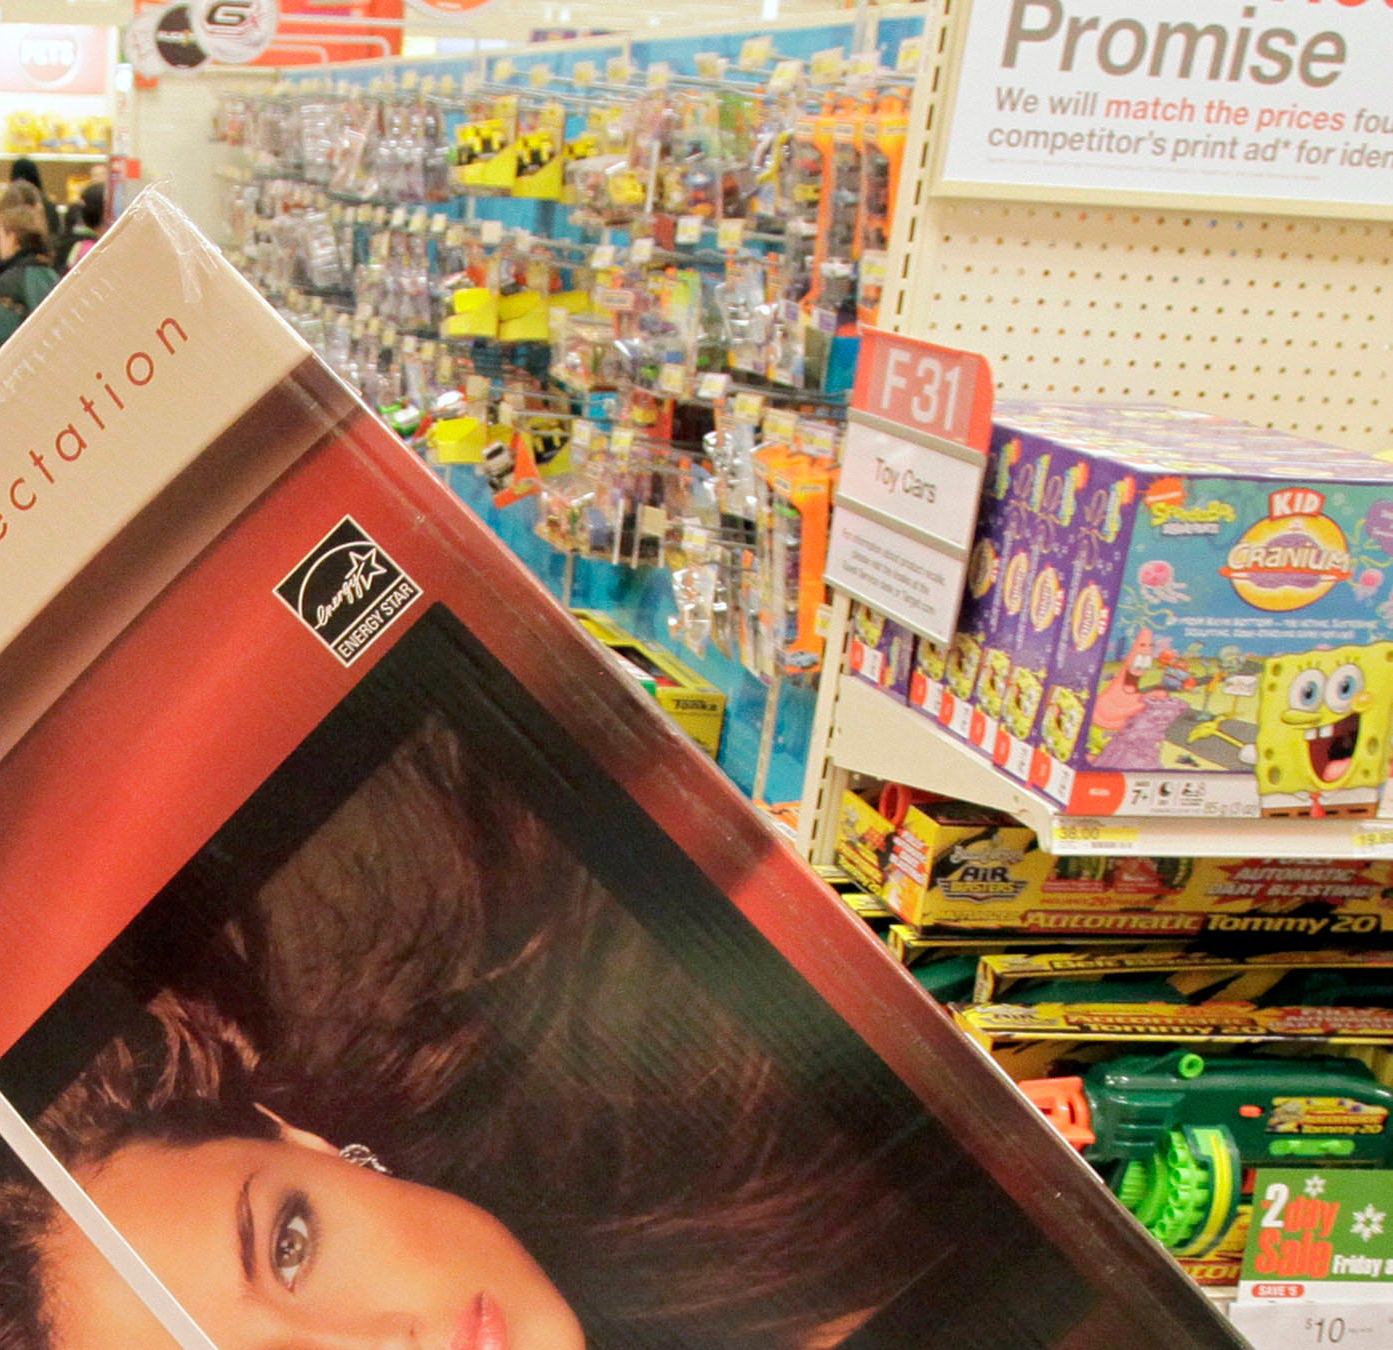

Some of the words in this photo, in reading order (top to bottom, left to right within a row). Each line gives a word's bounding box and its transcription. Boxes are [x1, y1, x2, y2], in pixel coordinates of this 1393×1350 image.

[1000, 0, 1348, 89] Promise
[995, 86, 1039, 115] We
[1048, 91, 1098, 118] will
[1104, 97, 1195, 124] match
[1205, 98, 1249, 127] the
[1255, 104, 1347, 133] prices
[987, 126, 1167, 157] competitor's
[1171, 133, 1237, 163] print
[1296, 140, 1337, 167] for
[875, 457, 900, 495] Toy
[901, 468, 938, 505] Cars
[1272, 490, 1321, 517] KID
[337, 610, 385, 659] ENERGY
[380, 582, 415, 618] STAR
[1023, 910, 1203, 932] Automatic
[1207, 914, 1330, 935] Tommy
[1330, 915, 1379, 933] 20
[1253, 1227, 1334, 1279] Sale
[1331, 1253, 1385, 1278] Friday
[1305, 1316, 1346, 1344] $10
